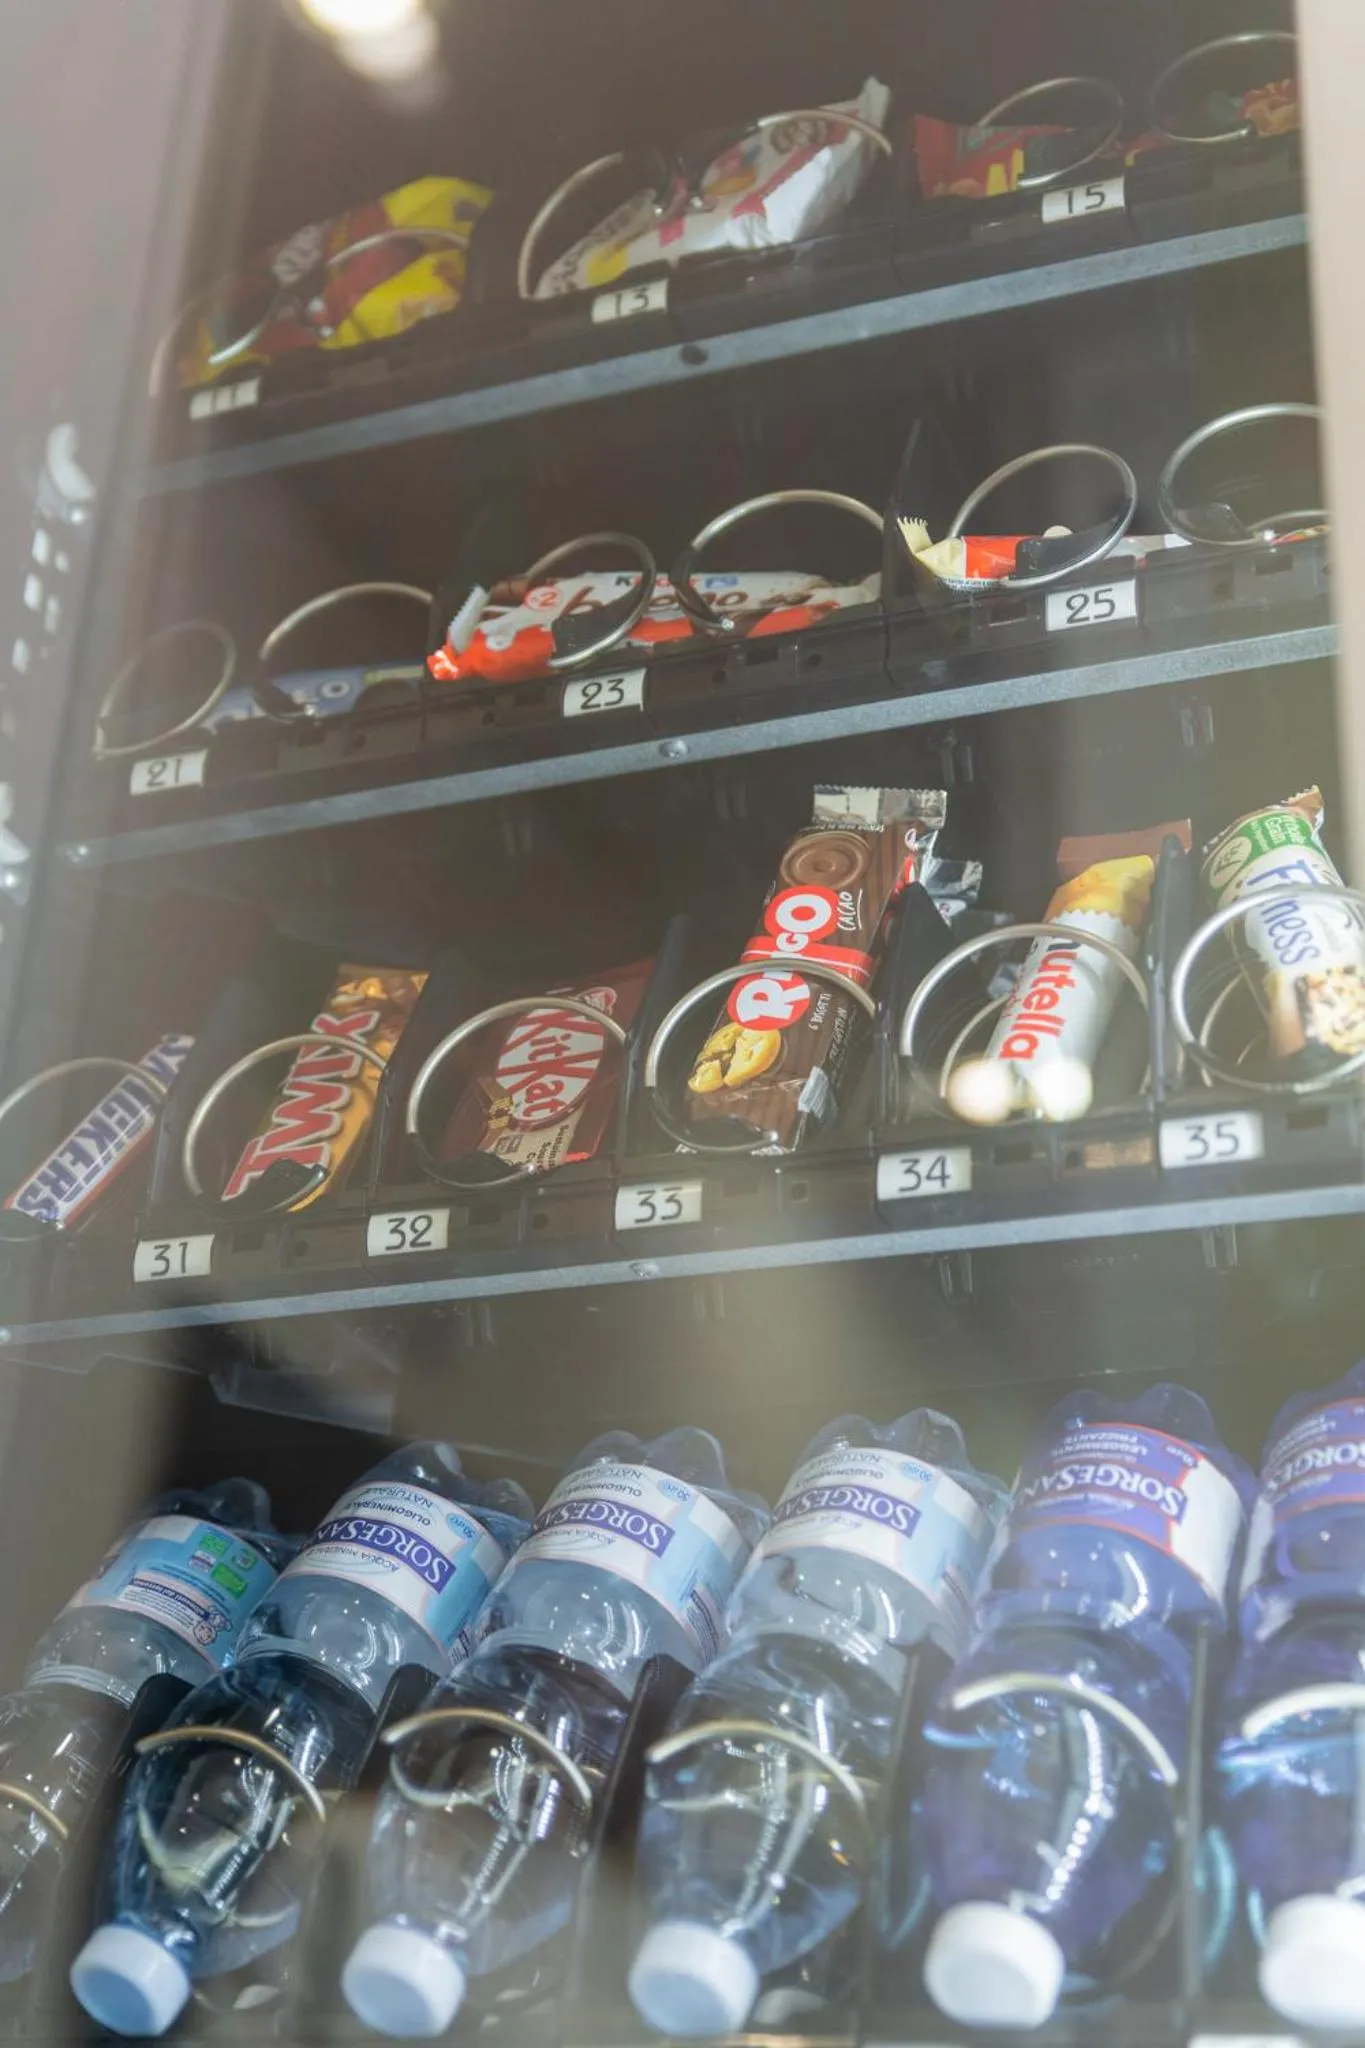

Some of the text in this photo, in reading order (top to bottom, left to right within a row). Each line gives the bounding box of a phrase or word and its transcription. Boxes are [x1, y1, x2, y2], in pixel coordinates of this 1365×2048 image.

[1066, 184, 1106, 213] 15
[614, 287, 649, 314] 13
[1066, 589, 1116, 624] 25
[581, 678, 625, 710] 23
[147, 758, 182, 786] 21
[837, 890, 853, 931] CACAO
[1184, 1119, 1241, 1161] 35
[898, 1154, 951, 1192] 34
[634, 1186, 683, 1223] 33
[385, 1214, 433, 1251] 32
[150, 1242, 189, 1277] 31
[361, 1553, 400, 1573] ACQUA
